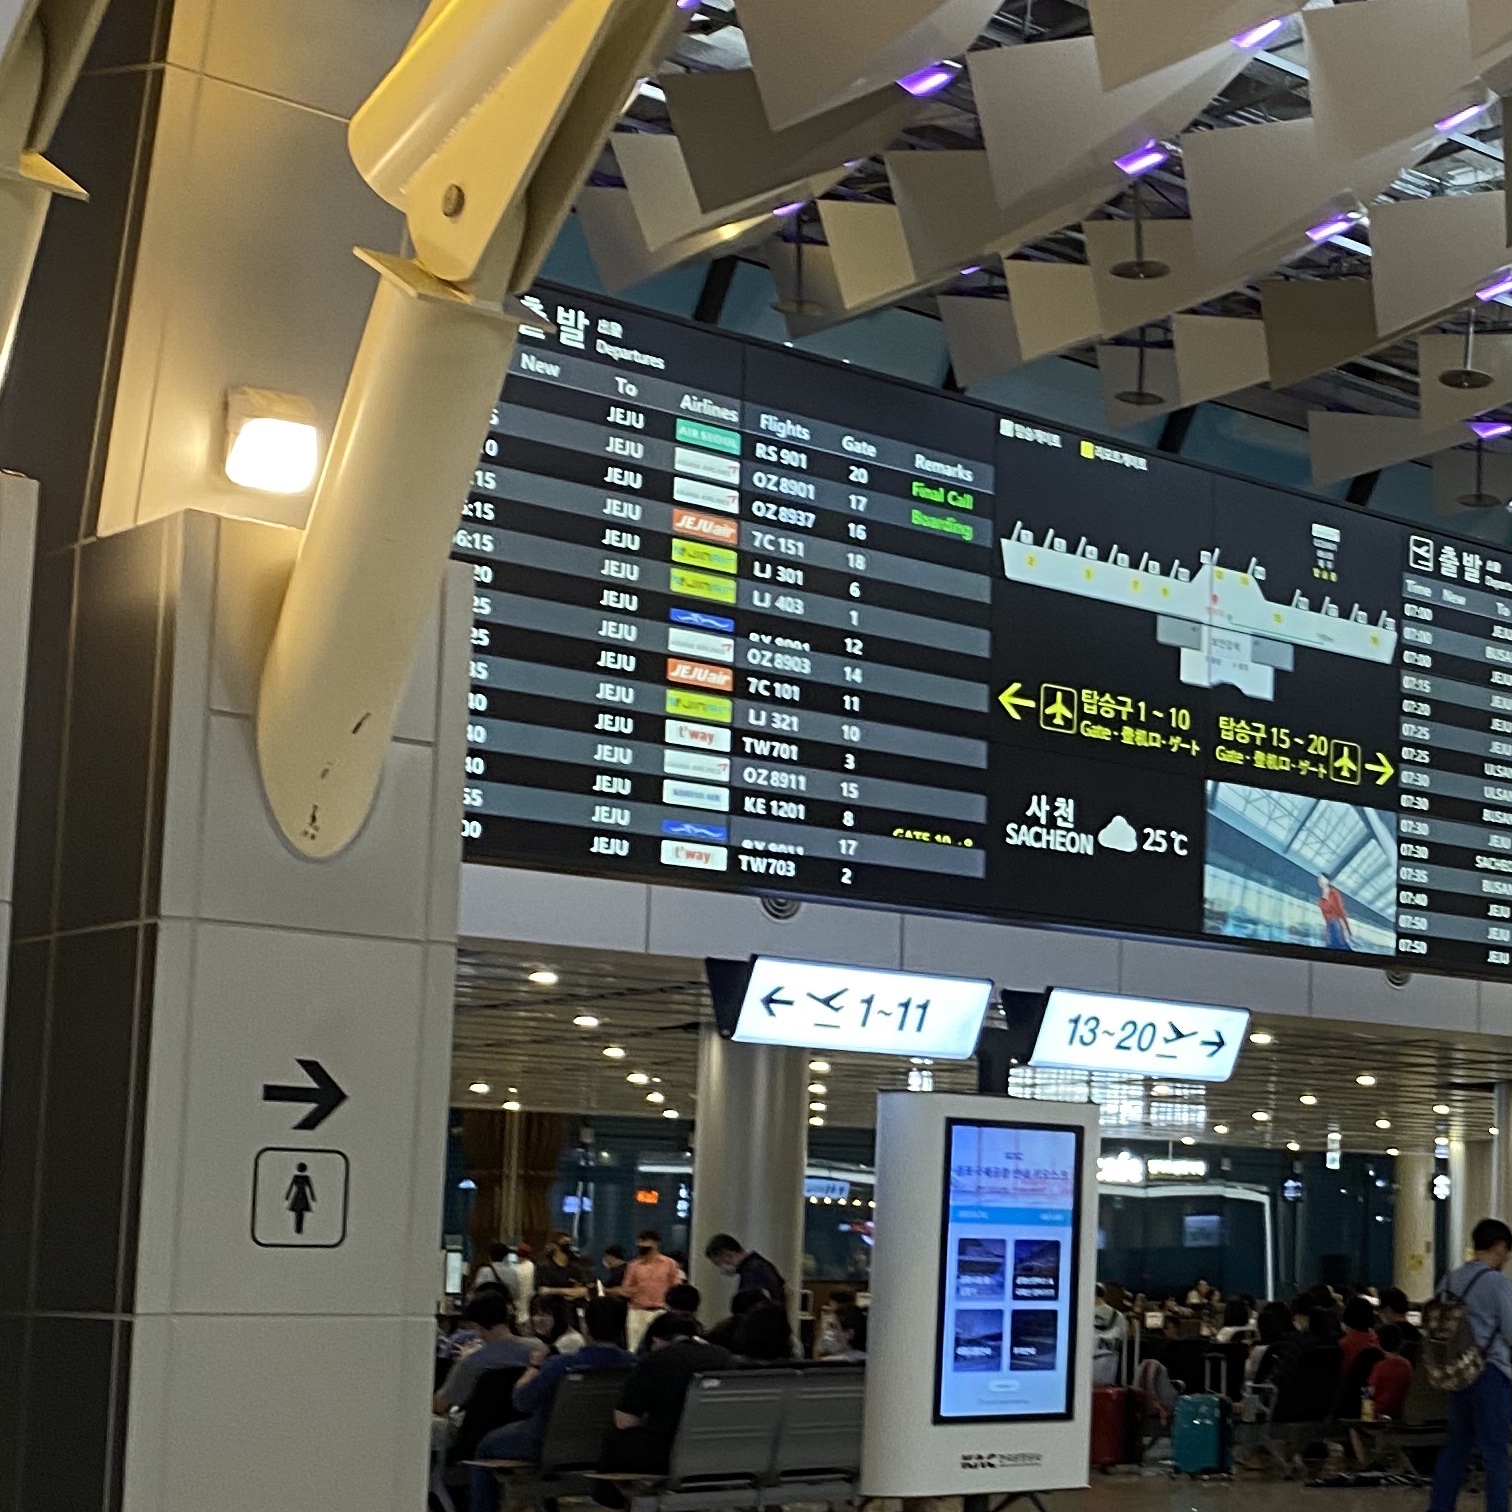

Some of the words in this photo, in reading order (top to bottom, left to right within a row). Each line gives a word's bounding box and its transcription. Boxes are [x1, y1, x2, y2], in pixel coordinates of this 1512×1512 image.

[596, 339, 665, 370] Departures
[520, 353, 561, 377] New
[615, 376, 638, 397] To
[680, 394, 739, 423] Airlines
[760, 414, 810, 441] Flights
[841, 436, 877, 457] Gate
[914, 454, 974, 482] Remarks
[607, 406, 645, 429] JEJU
[755, 443, 777, 461] RS
[780, 448, 808, 469] 901
[849, 466, 868, 484] 20
[912, 482, 944, 503] Final
[947, 490, 974, 510] Call
[604, 466, 642, 489] JEJU
[752, 501, 777, 520] OZ
[848, 523, 867, 541] 16
[606, 437, 644, 459] JEJU
[752, 472, 778, 492] OZ
[778, 478, 815, 500] 8901
[849, 494, 867, 512] 17
[911, 509, 974, 541] Boarding
[602, 528, 640, 551] JEJU
[776, 566, 804, 586] 301
[850, 582, 861, 598] 6
[603, 498, 642, 521] JEJU
[752, 531, 775, 551] 7C
[779, 536, 804, 557] 151
[847, 553, 866, 571] 18
[601, 559, 639, 581] JEJU
[849, 610, 859, 626] 1
[600, 589, 638, 611] JEJU
[844, 638, 863, 655] 12
[597, 650, 636, 672] JEJU
[671, 663, 731, 687] JEJUair
[747, 677, 770, 696] 7C
[773, 682, 800, 702] 101
[843, 695, 860, 711] 11
[598, 620, 637, 642] JEJU
[747, 648, 773, 668] OZ
[844, 666, 863, 684] 14
[596, 683, 635, 704] JEJU
[772, 711, 799, 733] 321
[842, 725, 861, 742] 10
[1081, 688, 1134, 721] 탑승구
[1138, 701, 1146, 723] 1
[1169, 707, 1191, 731] 10
[1219, 715, 1267, 746] 탑승구
[1271, 727, 1291, 749] 15
[1307, 734, 1328, 757] 20
[595, 713, 633, 734] JEJU
[679, 725, 715, 745] t'way
[844, 753, 856, 770] 3
[594, 744, 632, 765] JEJU
[743, 767, 768, 785] OZ
[770, 771, 807, 792] 8911
[840, 782, 859, 799] 15
[593, 775, 631, 795] JEJU
[744, 796, 766, 815] KE
[770, 800, 806, 820] 1201
[843, 810, 854, 827] 8
[592, 805, 630, 826] JEJU
[839, 839, 857, 856] 17
[1005, 822, 1094, 856] SACHEON
[590, 836, 629, 856] JEJU
[675, 844, 711, 865] t'way
[841, 868, 852, 884] 2
[859, 993, 932, 1033] 1~11
[1066, 1013, 1157, 1052] 13~20
